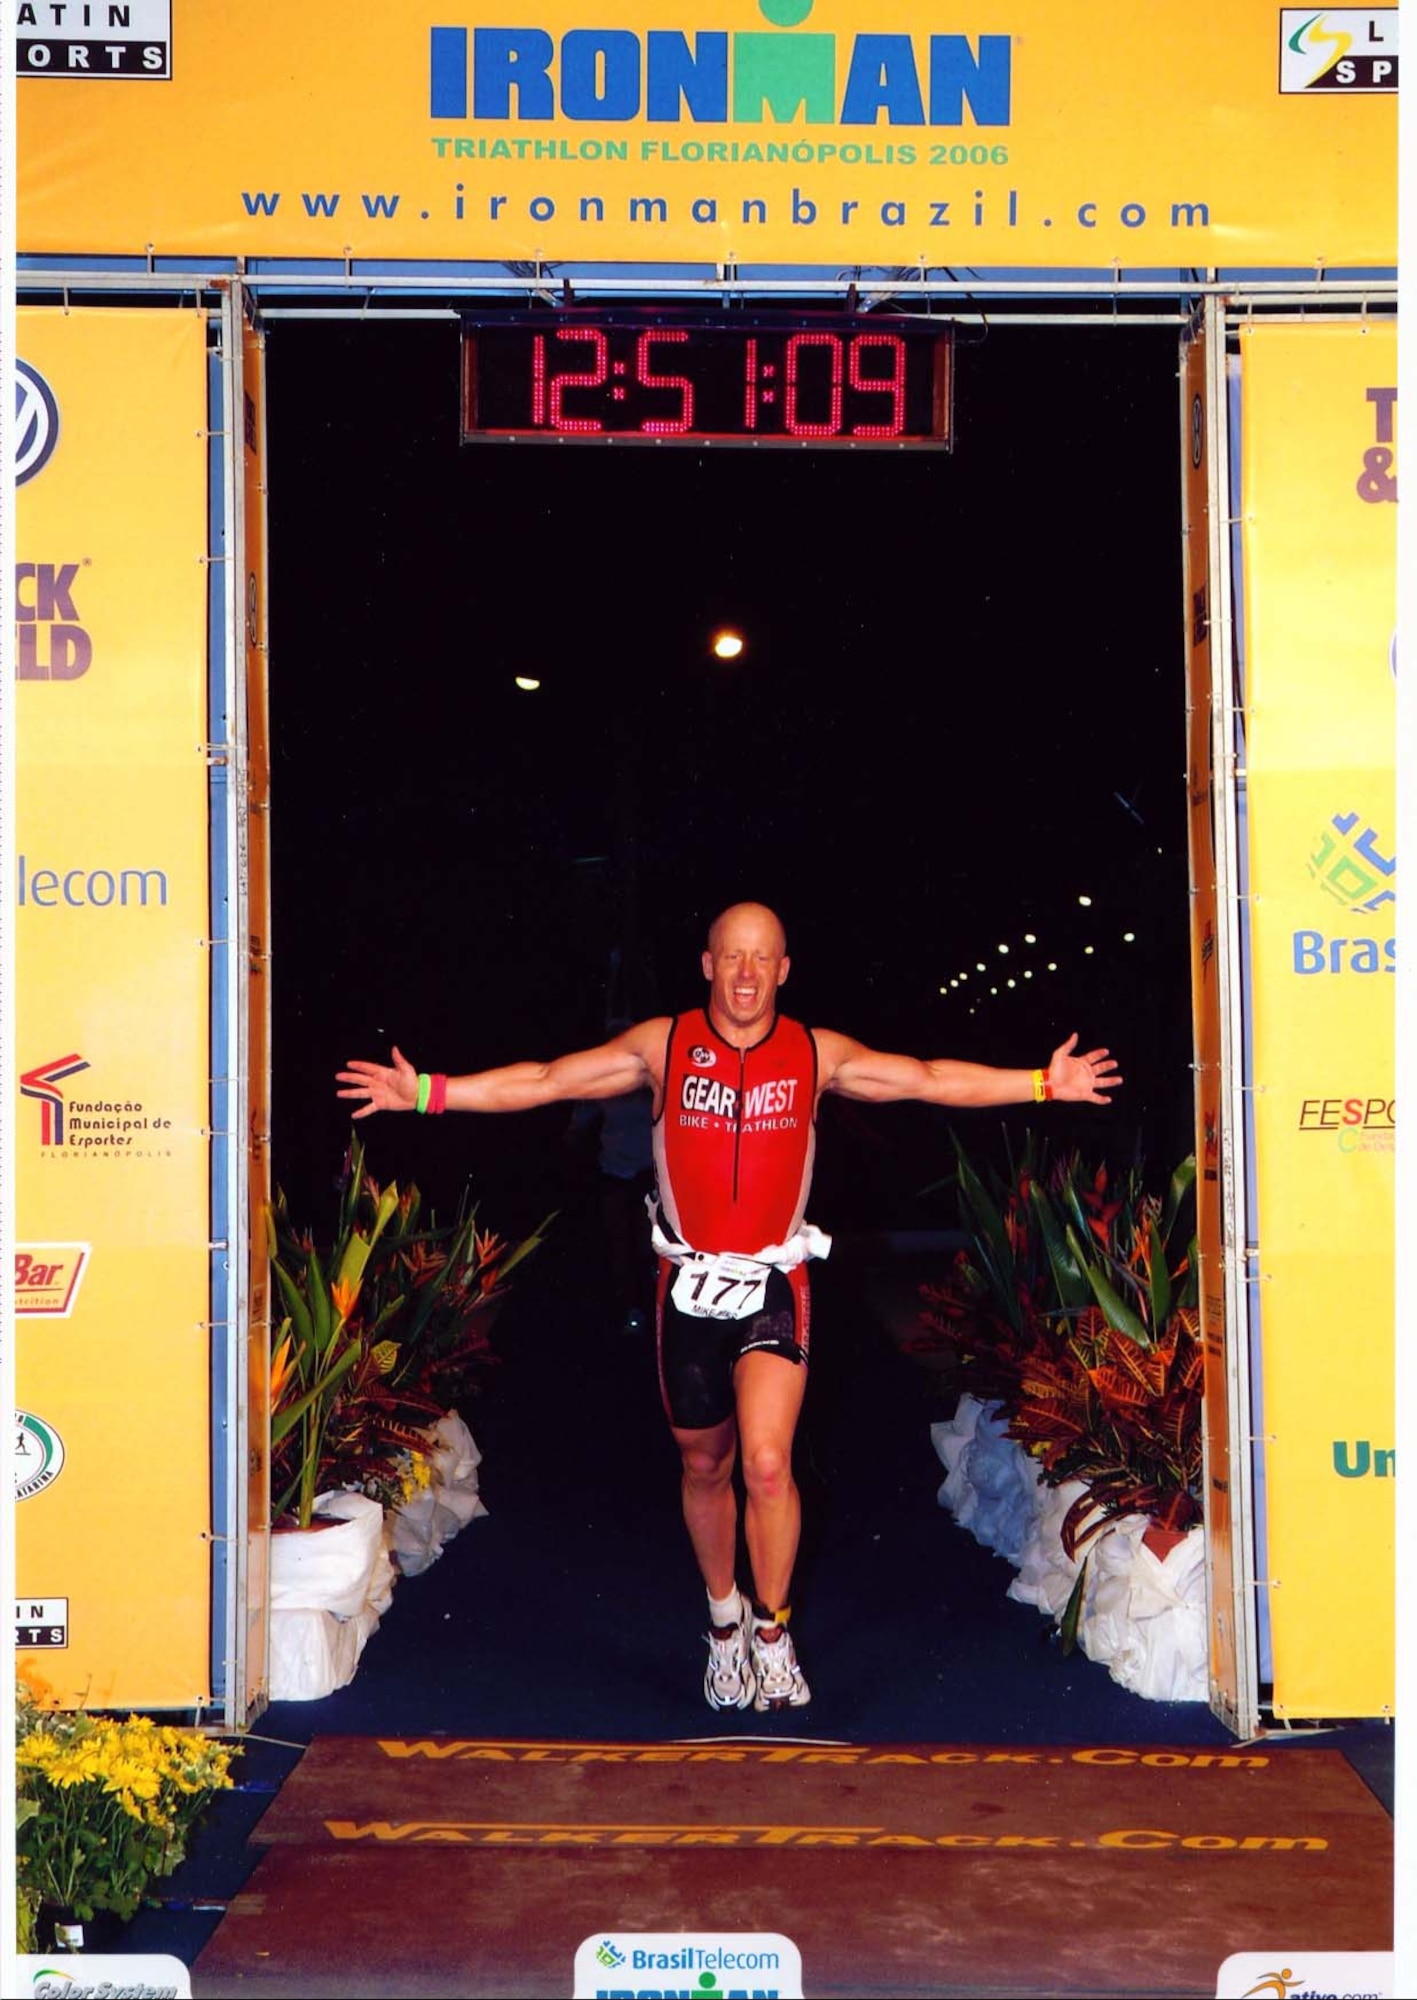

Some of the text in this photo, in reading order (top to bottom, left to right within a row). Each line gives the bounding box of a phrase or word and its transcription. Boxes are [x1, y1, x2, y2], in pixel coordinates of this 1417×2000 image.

[17, 3, 130, 27] ATIN
[1369, 21, 1384, 42] L
[27, 44, 163, 69] ORTS
[430, 27, 1012, 126] IRONMAN
[1336, 60, 1392, 84] SP
[431, 138, 1010, 166] TRIATHLON FLORIANÓPOLIS 2006
[15, 624, 92, 681] LD
[18, 856, 168, 906] lecom
[69, 1100, 143, 1113] Fundação
[682, 1075, 798, 1119] GEAR WEST
[69, 1117, 172, 1132] Municipal de
[680, 1115, 708, 1129] BIKE
[69, 1134, 133, 1148] Esportes
[15, 1254, 64, 1286] Bar
[690, 1271, 762, 1310] 177
[15, 1470, 54, 1498] ATARINA
